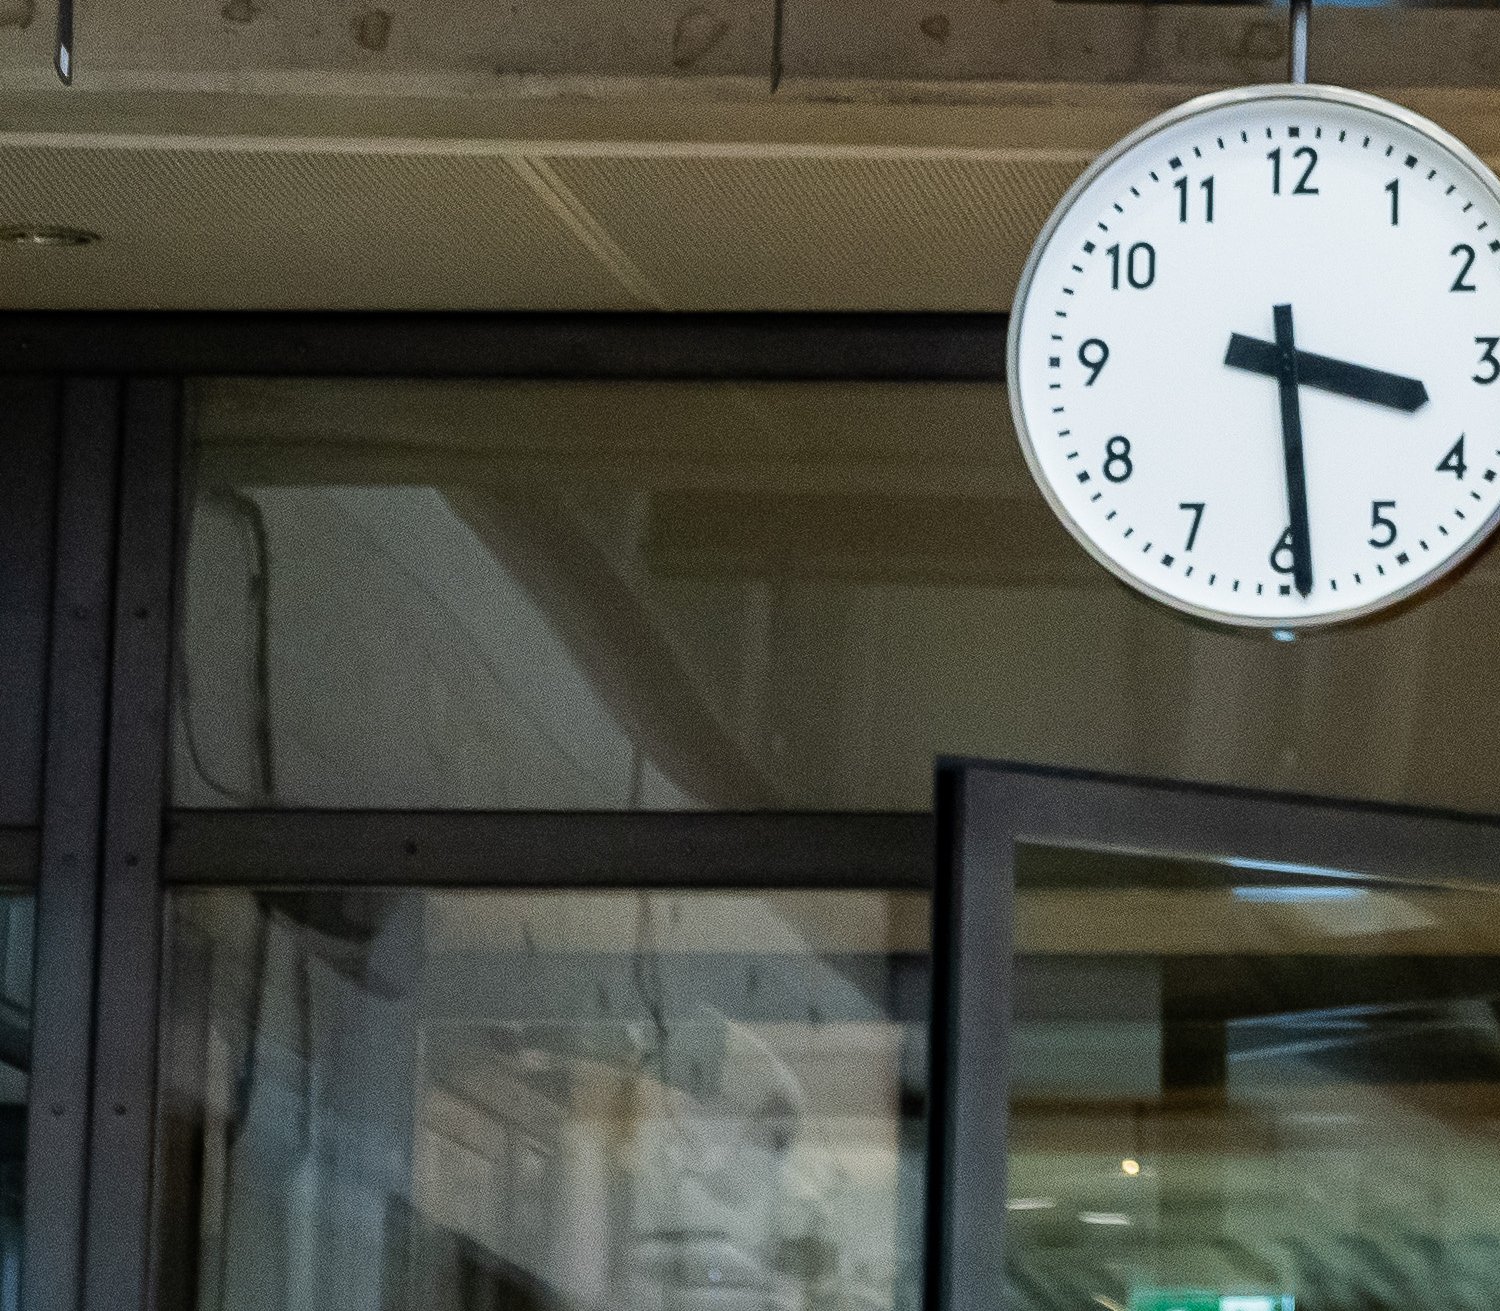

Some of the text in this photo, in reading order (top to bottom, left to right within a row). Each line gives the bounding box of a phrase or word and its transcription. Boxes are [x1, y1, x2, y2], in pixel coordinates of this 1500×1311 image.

[1267, 146, 1319, 195] 12
[1174, 175, 1214, 223] 11
[1385, 178, 1399, 226] 1
[1106, 241, 1156, 290] 10
[1450, 243, 1476, 292] 2
[1077, 338, 1110, 387] 9
[1472, 336, 1500, 385] 3
[1102, 435, 1133, 484] 8
[1435, 434, 1468, 480] 4
[1179, 502, 1206, 552] 7
[1269, 524, 1301, 574] 6
[1368, 500, 1398, 549] 5
